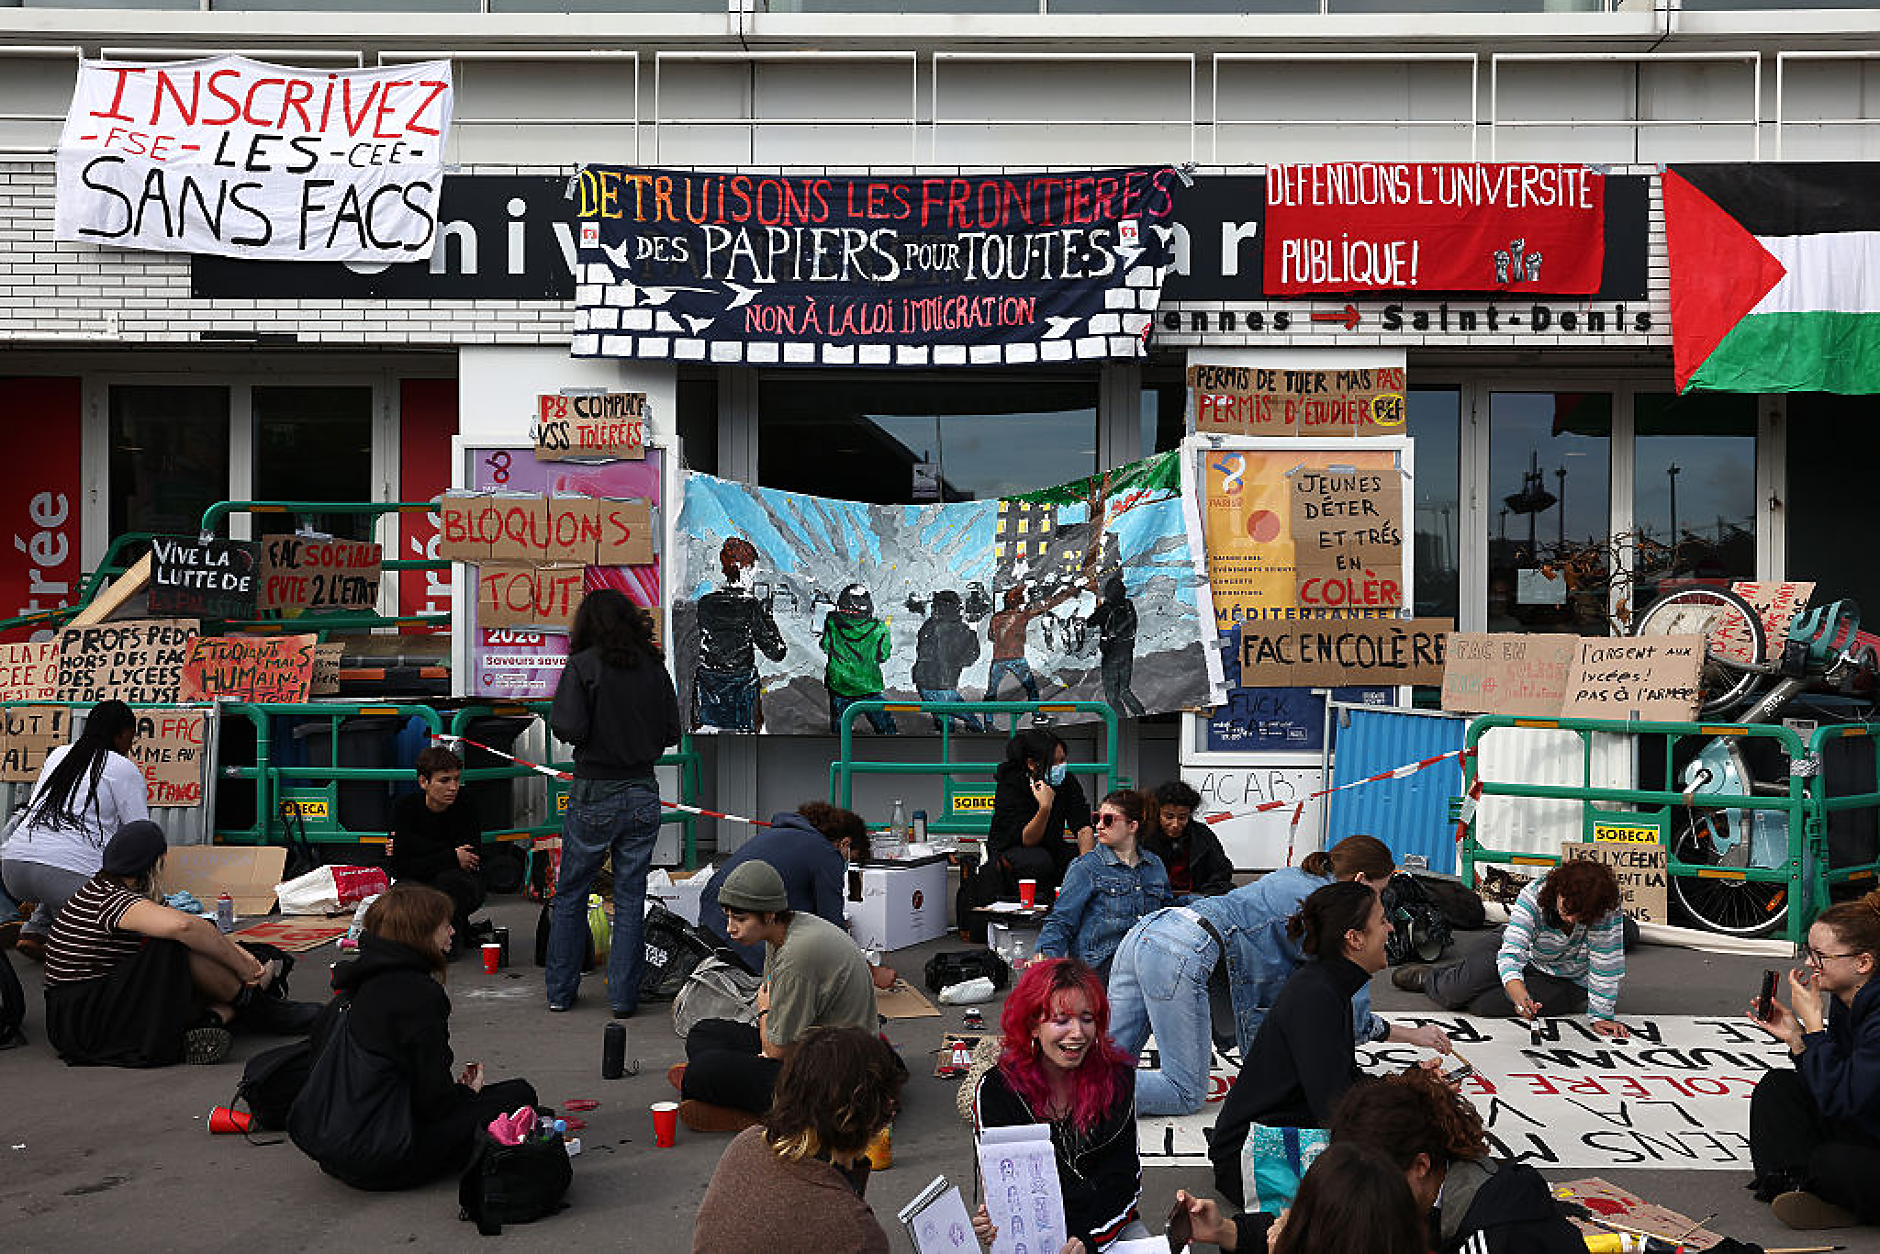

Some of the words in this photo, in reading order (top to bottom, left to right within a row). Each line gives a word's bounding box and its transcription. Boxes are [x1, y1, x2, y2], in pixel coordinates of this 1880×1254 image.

[89, 68, 448, 139] INSCRiVEZ
[213, 130, 321, 173] LES
[79, 156, 273, 248] SANS
[298, 180, 434, 250] FACS
[848, 180, 911, 220] LES
[635, 235, 690, 263] DES
[700, 223, 901, 284] PAPIERS
[904, 242, 960, 270] POUR
[745, 304, 796, 334] NON
[828, 302, 859, 336] LA
[1163, 309, 1292, 333] ennes
[1382, 304, 1652, 332] Saint-Denis
[1197, 366, 1249, 390] PERMiS
[1256, 368, 1277, 392] DE
[1284, 369, 1328, 394] TUER
[1336, 369, 1371, 391] MAiS
[1376, 368, 1403, 390] PAS
[541, 395, 568, 422] P8
[538, 420, 570, 450] VSS
[1298, 473, 1382, 494] JEUNES
[1305, 496, 1380, 520] DÉTER
[445, 506, 631, 549] BLOQUONS
[1319, 530, 1347, 549] ET
[205, 549, 230, 567] LA
[269, 539, 303, 570] FAC
[1336, 555, 1362, 571] EN
[157, 566, 218, 589] LUTTE
[221, 573, 252, 592] DE
[267, 575, 309, 605] PUTE
[311, 573, 326, 606] 2
[482, 572, 581, 618] TOUT
[9, 645, 32, 663] LA
[60, 627, 141, 655] PROFS
[1242, 633, 1296, 667] FAC
[1299, 633, 1332, 664] EN
[1336, 628, 1446, 670] COLÈRE
[61, 652, 107, 671] HORS
[114, 652, 147, 668] DES
[59, 670, 95, 688] DES
[161, 717, 203, 745] FAC
[147, 781, 201, 801] STANCE
[1200, 771, 1295, 805] ACAB
[1597, 829, 1655, 842] SOBECA
[1645, 873, 1666, 888] LA
[1564, 1097, 1705, 1129] LA
